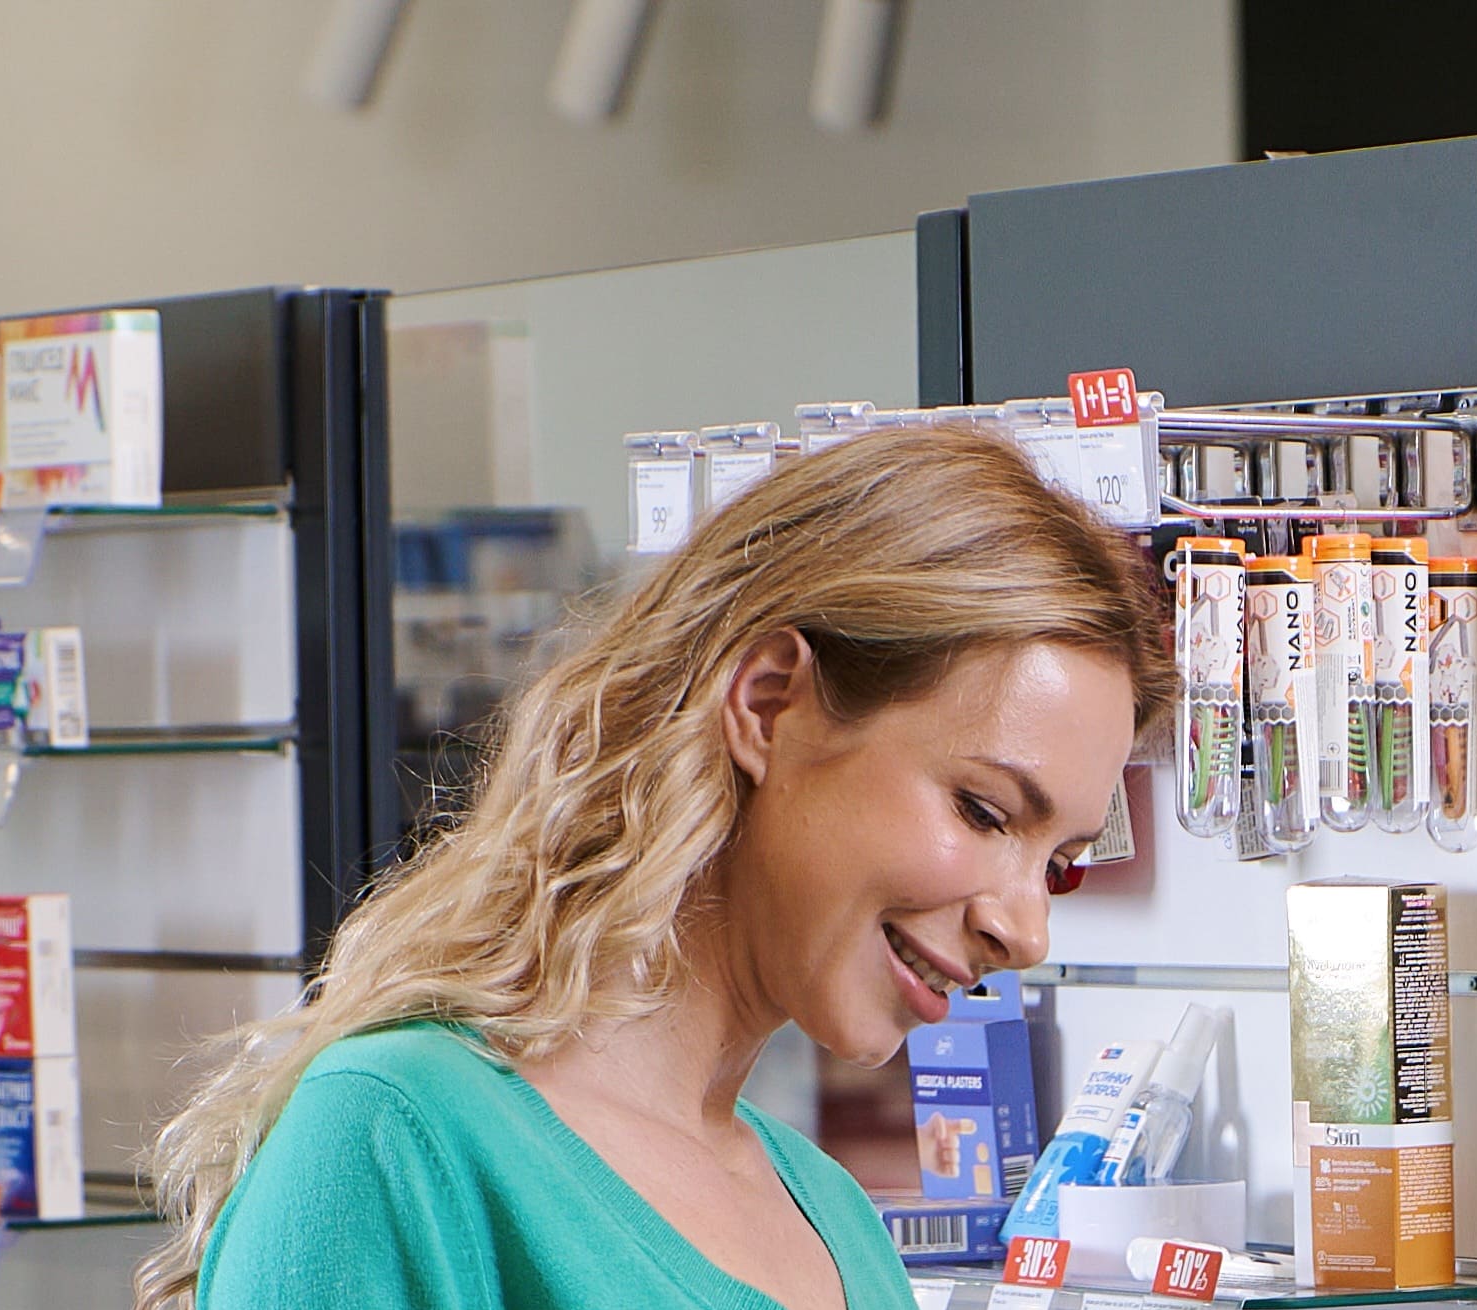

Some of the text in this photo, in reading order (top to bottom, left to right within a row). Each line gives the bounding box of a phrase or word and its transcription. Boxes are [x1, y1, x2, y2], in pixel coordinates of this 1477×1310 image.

[1076, 373, 1133, 418] 1+1=3
[1096, 475, 1122, 505] 120
[1286, 590, 1302, 671] NANO
[1404, 572, 1417, 652] NANO
[946, 1075, 983, 1089] PLASTERS
[1325, 1126, 1360, 1146] Sun
[1014, 1238, 1059, 1279] -30%
[1165, 1248, 1211, 1290] -50%
